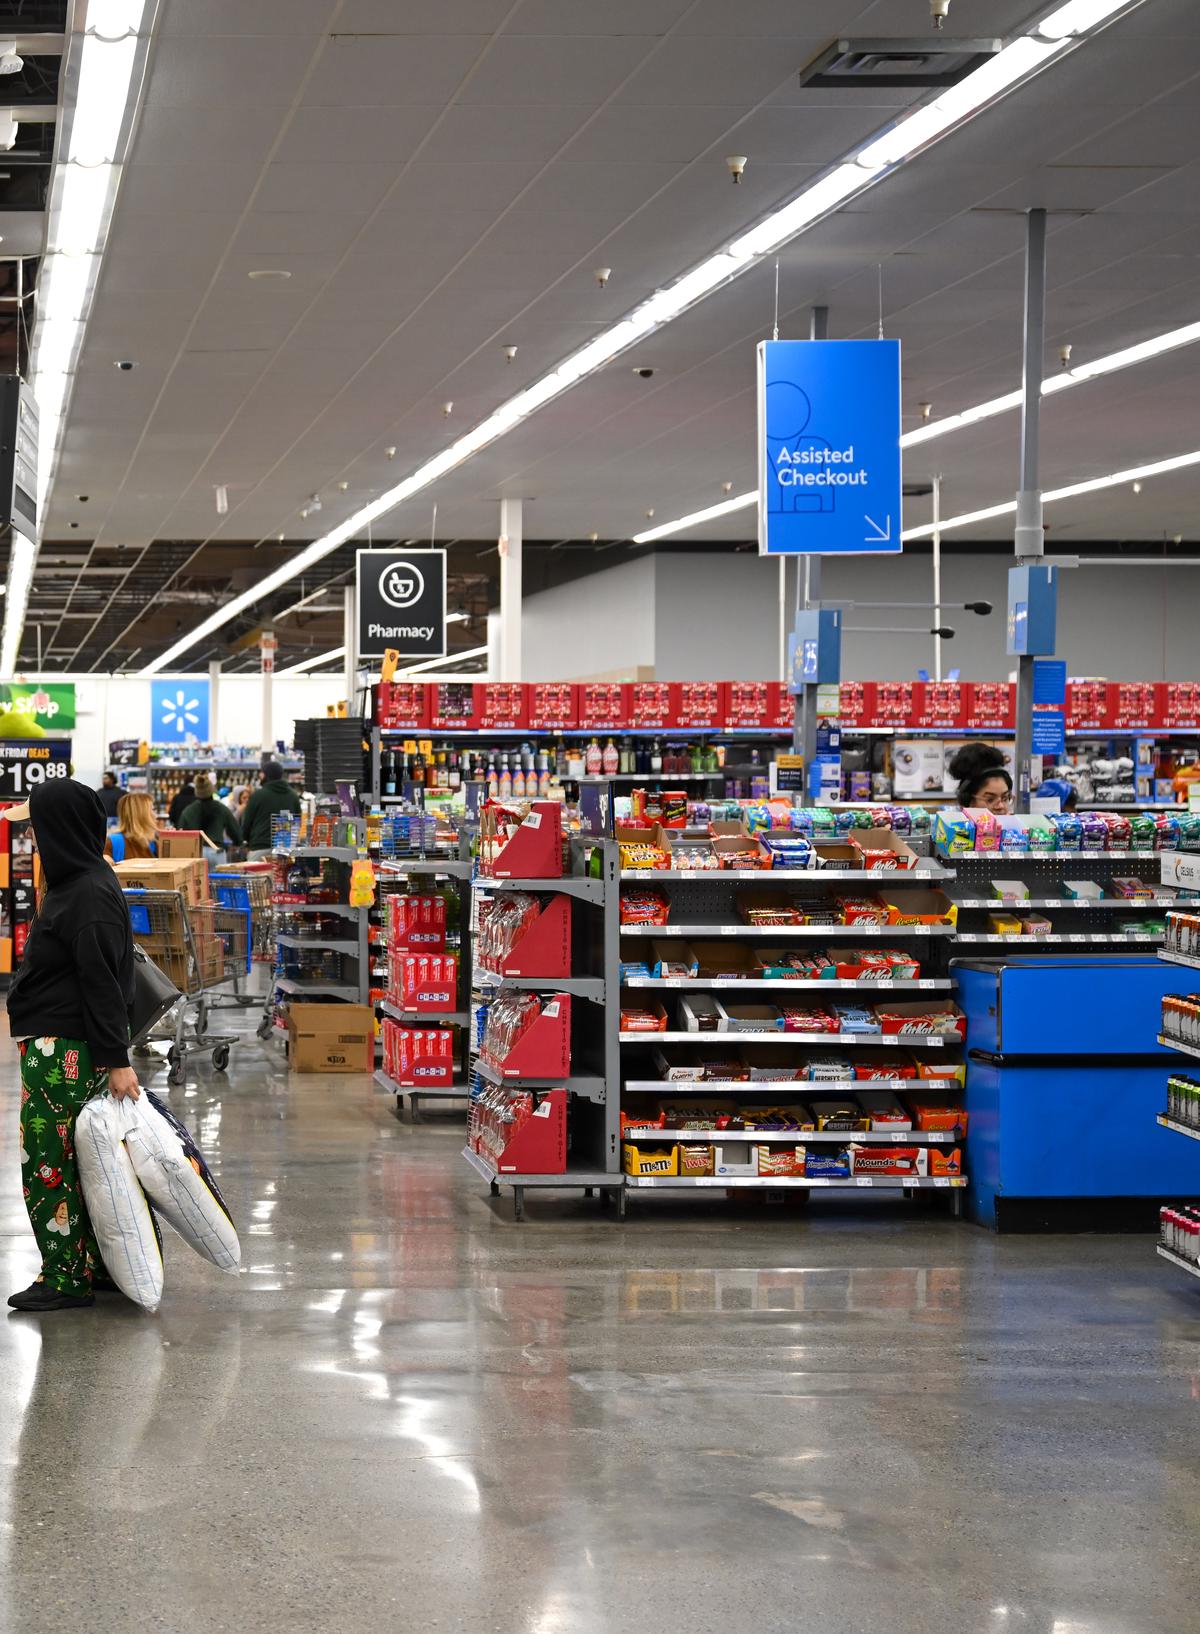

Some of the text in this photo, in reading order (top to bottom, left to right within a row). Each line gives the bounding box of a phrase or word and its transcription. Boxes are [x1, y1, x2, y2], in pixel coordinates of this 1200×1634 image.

[777, 446, 854, 464] Assisted
[778, 467, 868, 487] Checkout
[368, 624, 434, 640] Pharmacy
[29, 747, 50, 758] DEALS
[855, 1158, 896, 1168] Mounds
